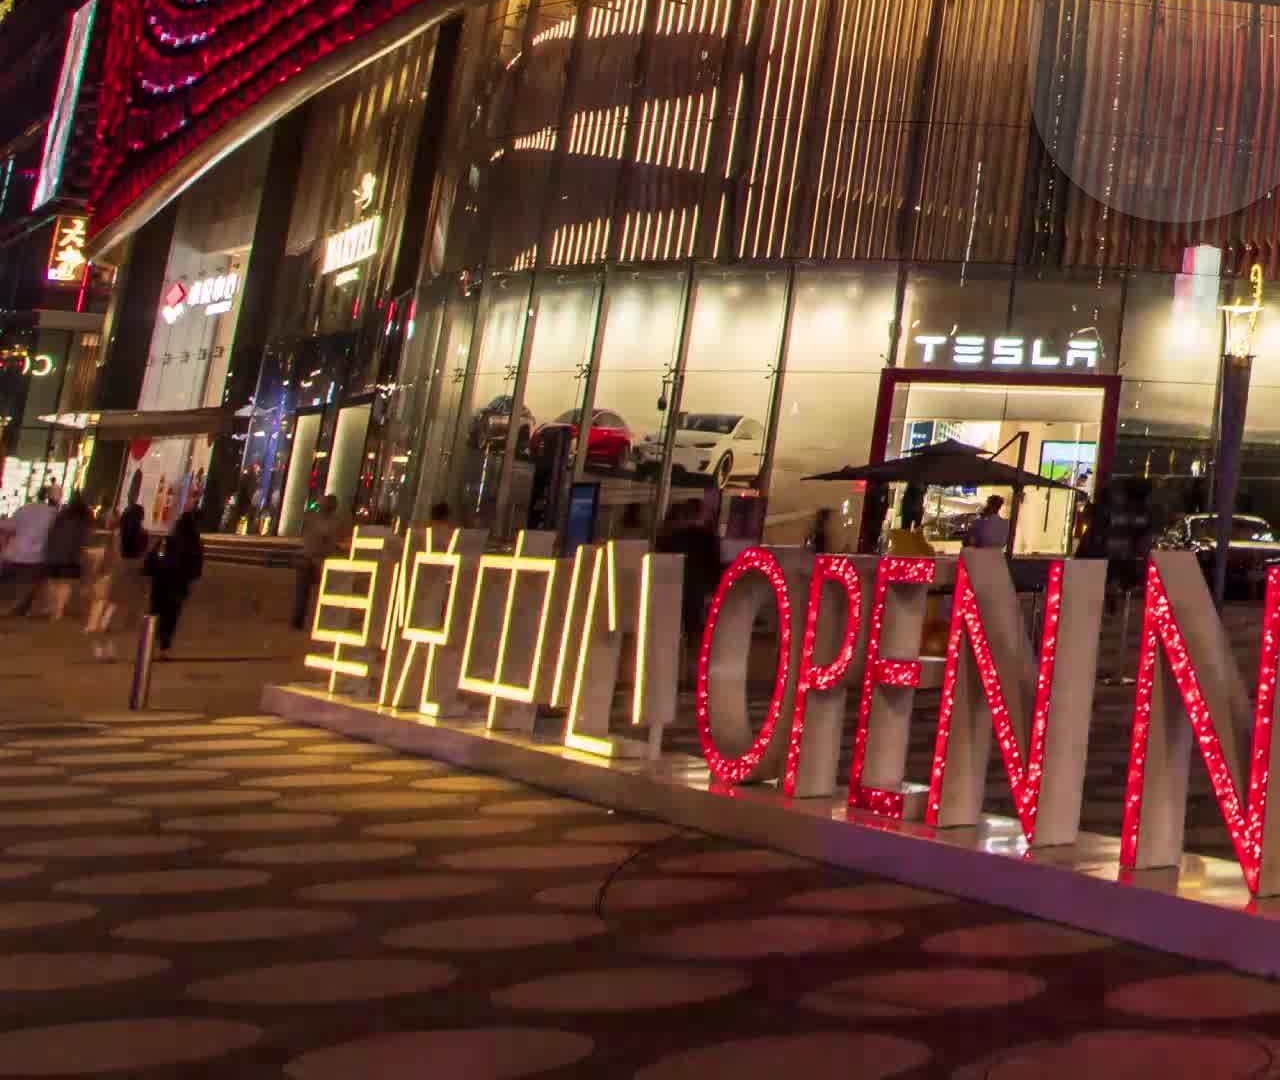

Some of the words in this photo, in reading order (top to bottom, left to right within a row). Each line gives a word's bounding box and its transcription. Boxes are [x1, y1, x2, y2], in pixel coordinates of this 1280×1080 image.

[913, 335, 1098, 367] TESLA
[304, 520, 652, 756] 卓悦中心
[698, 547, 1063, 845] OPEN
